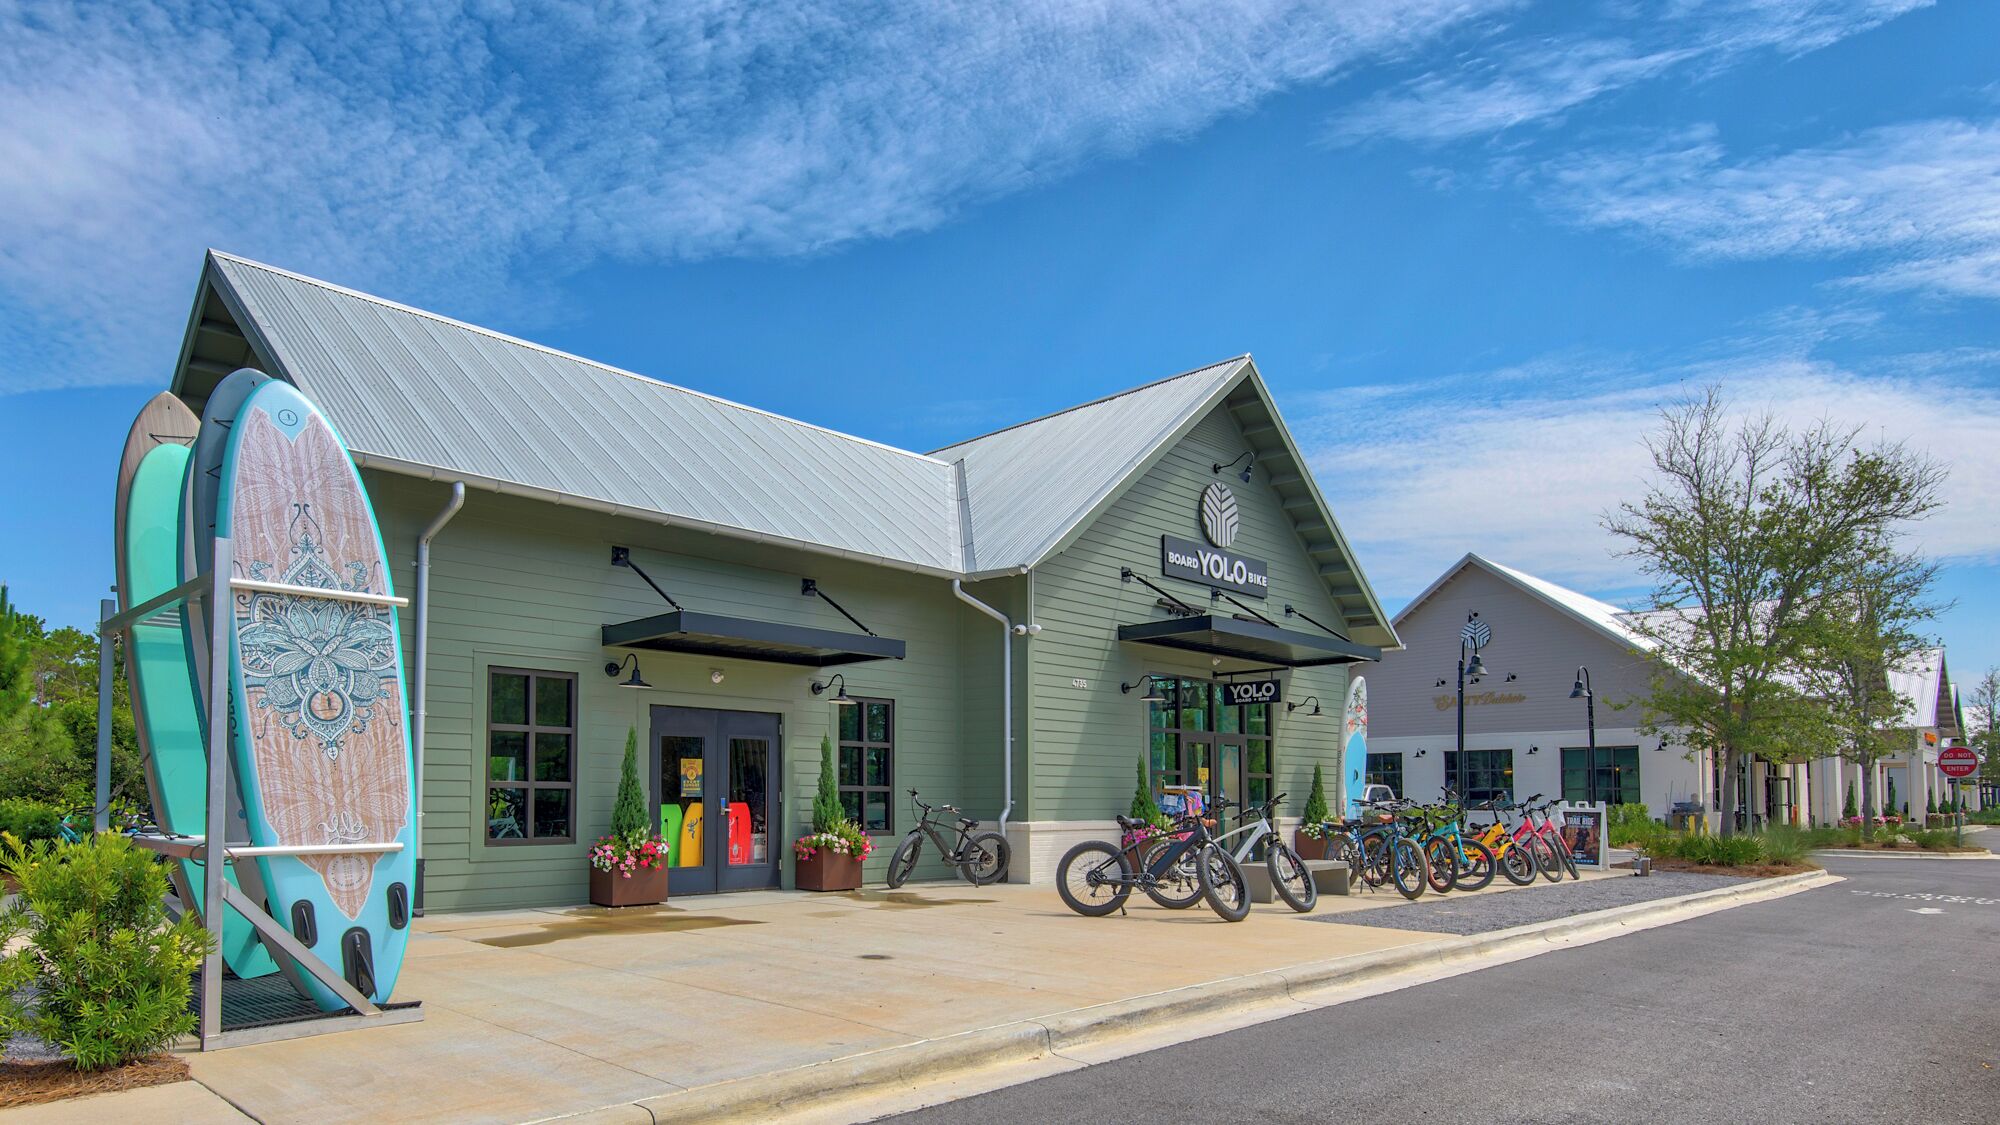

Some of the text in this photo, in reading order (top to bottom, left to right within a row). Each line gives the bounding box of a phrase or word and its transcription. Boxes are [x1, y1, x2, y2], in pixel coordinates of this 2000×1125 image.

[1168, 550, 1267, 587] BOARD YOLO BIKE
[1072, 677, 1088, 688] 4735
[1229, 682, 1275, 699] YOLO
[1567, 816, 1594, 826] TRAIL RIDE
